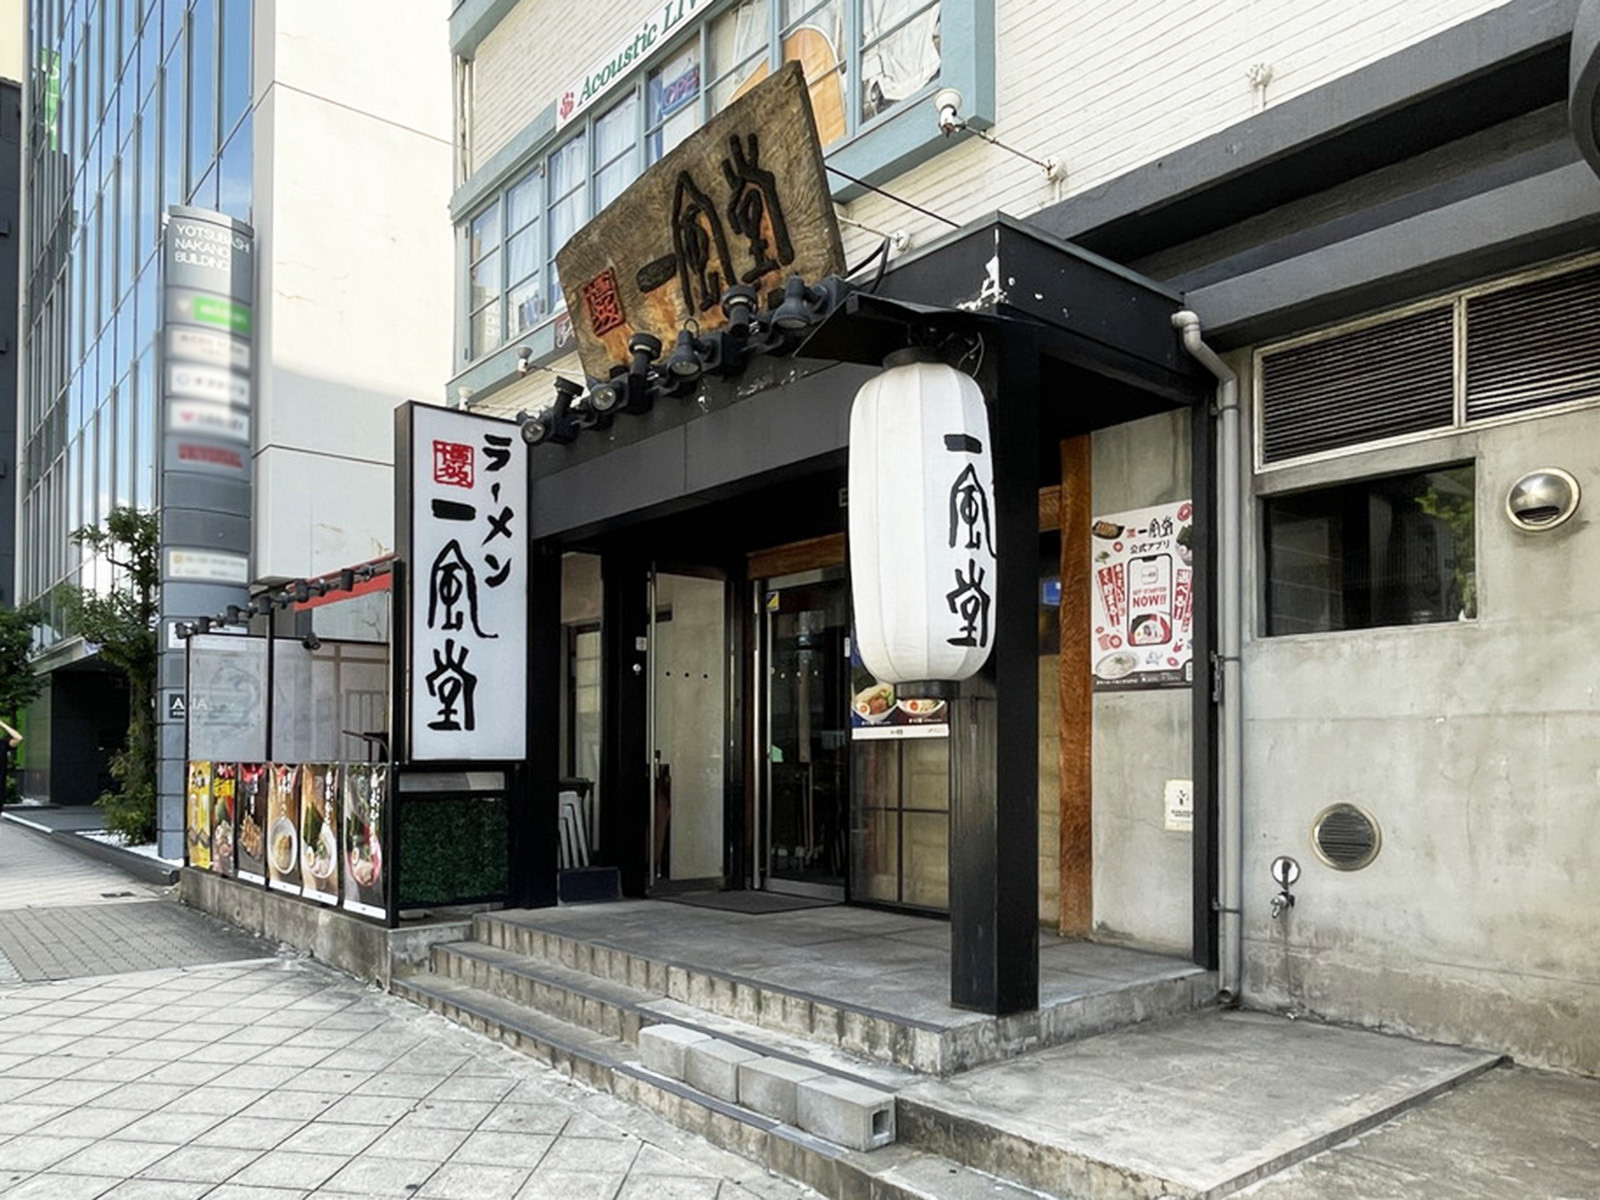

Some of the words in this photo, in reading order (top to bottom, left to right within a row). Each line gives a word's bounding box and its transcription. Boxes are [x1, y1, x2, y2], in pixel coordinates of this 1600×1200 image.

[577, 23, 657, 107] Acoustic
[174, 238, 230, 258] NAKANO
[174, 251, 230, 271] BUILDING
[176, 224, 250, 253] YOTSUBASHI
[635, 132, 795, 316] 一風堂
[481, 434, 514, 588] ラーメン
[944, 433, 997, 648] 一風堂
[1138, 516, 1173, 538] 一風堂
[425, 499, 499, 731] 一風堂
